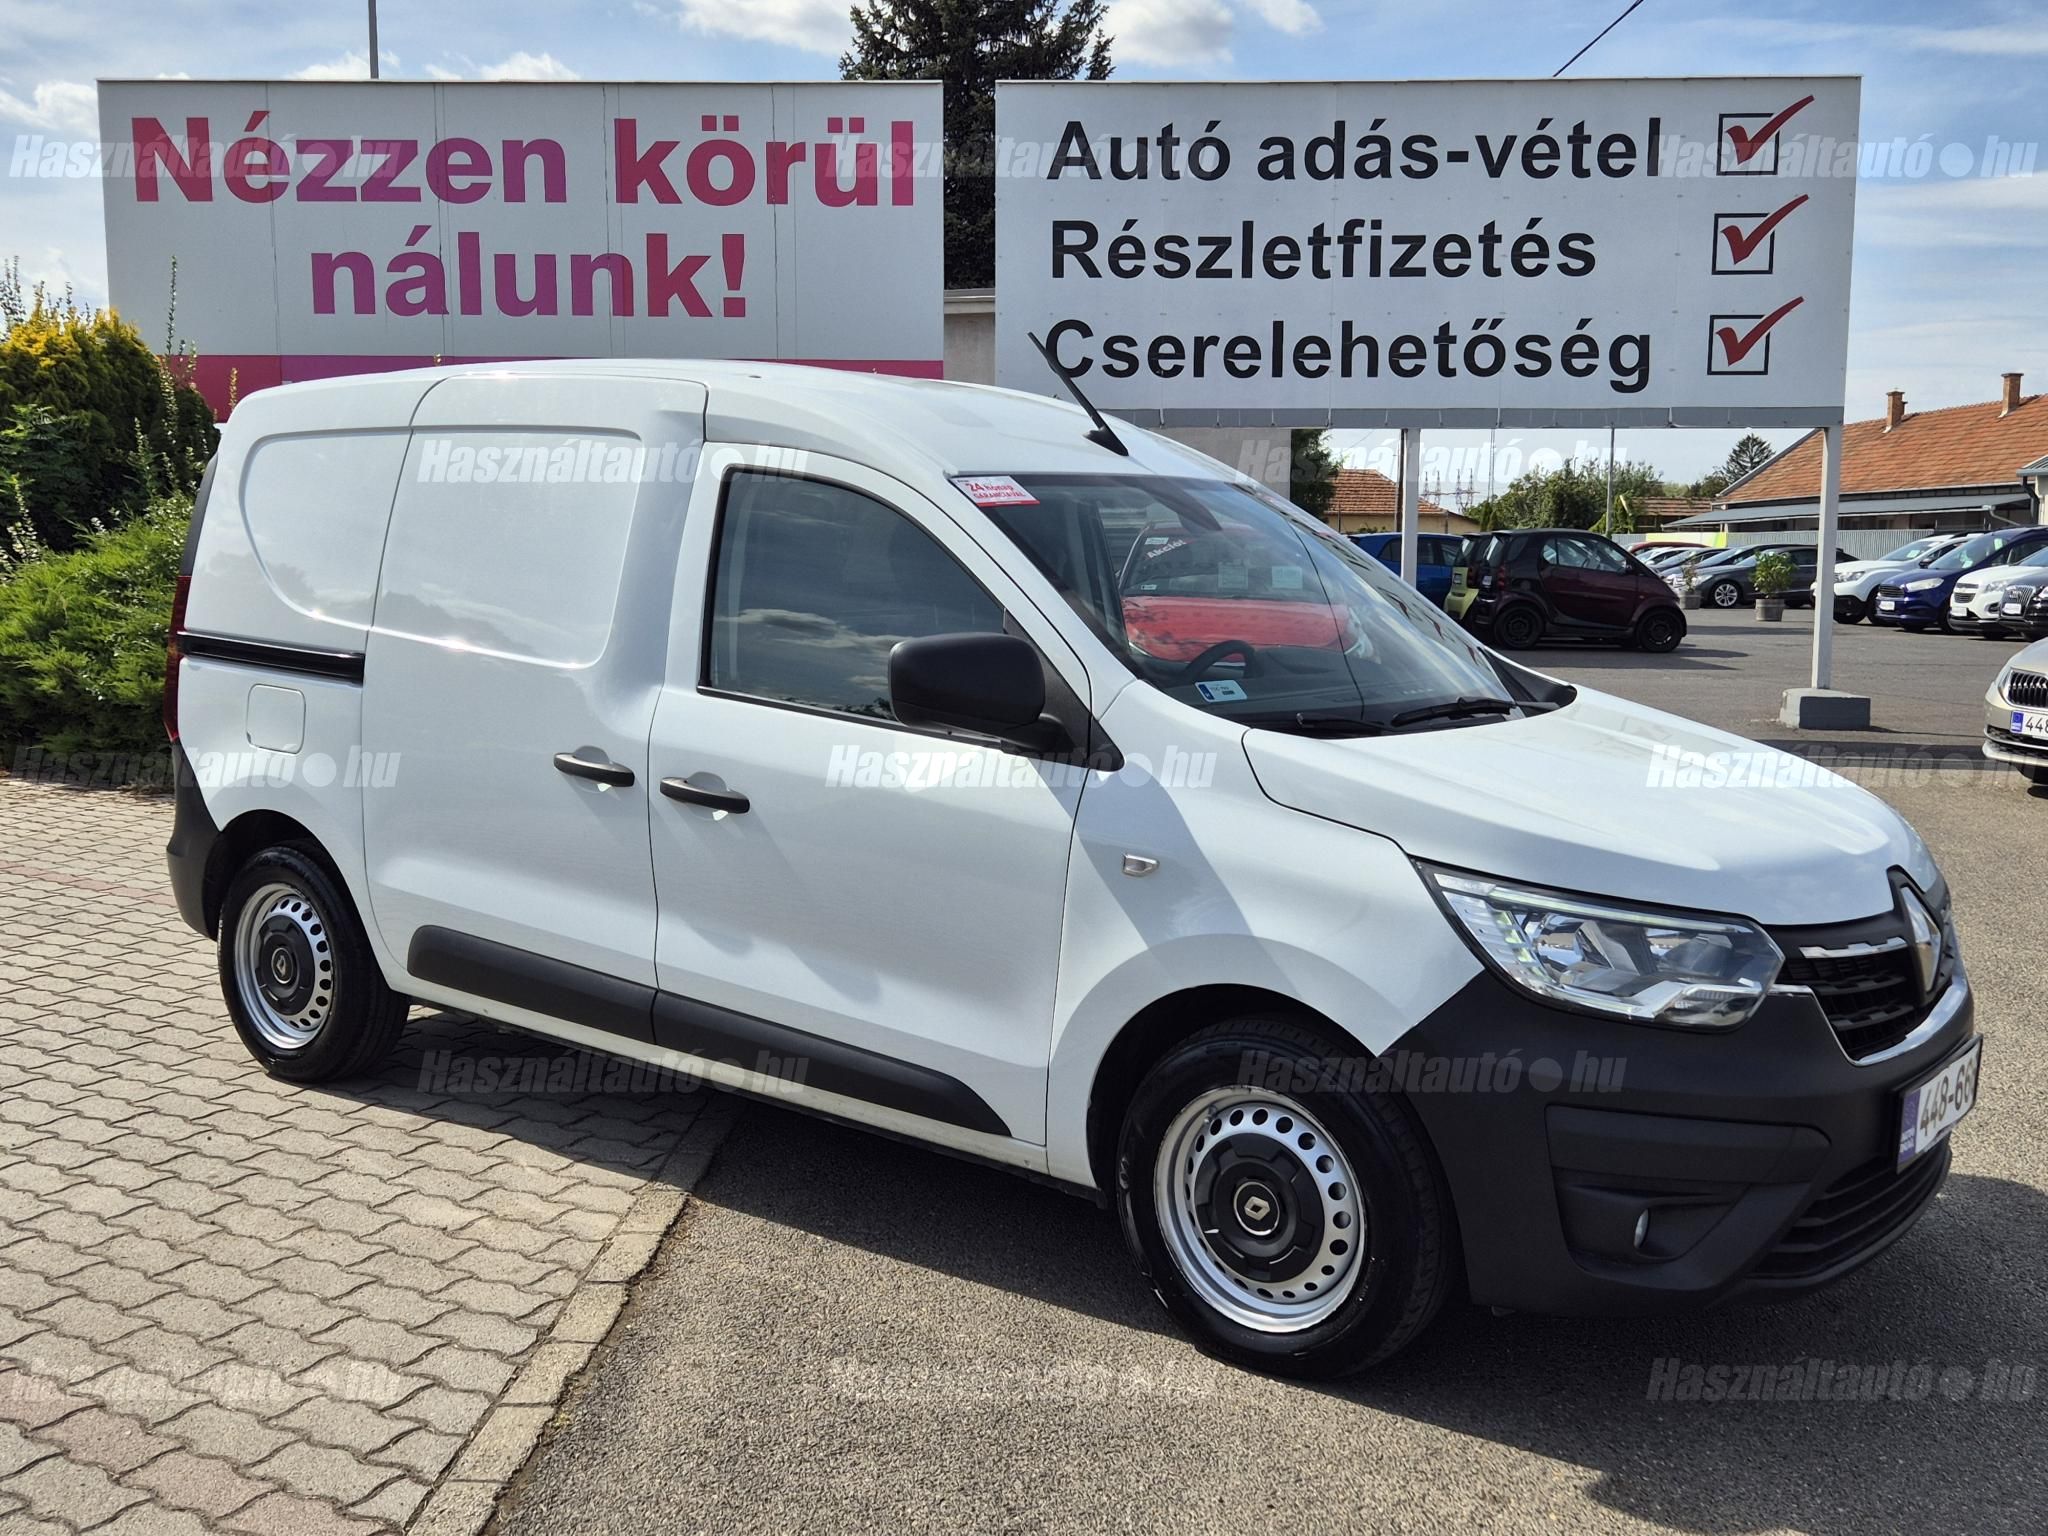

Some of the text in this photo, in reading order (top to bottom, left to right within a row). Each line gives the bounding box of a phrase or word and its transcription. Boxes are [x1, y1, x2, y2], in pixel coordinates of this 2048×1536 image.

[133, 111, 914, 208] Nézzen körül
[1047, 117, 1661, 181] Autó adás-vétel
[313, 225, 746, 318] nálunk!
[1052, 218, 1596, 280] Részletfizetés
[1046, 317, 1651, 394] Cserelehetőség
[966, 483, 985, 492] 24
